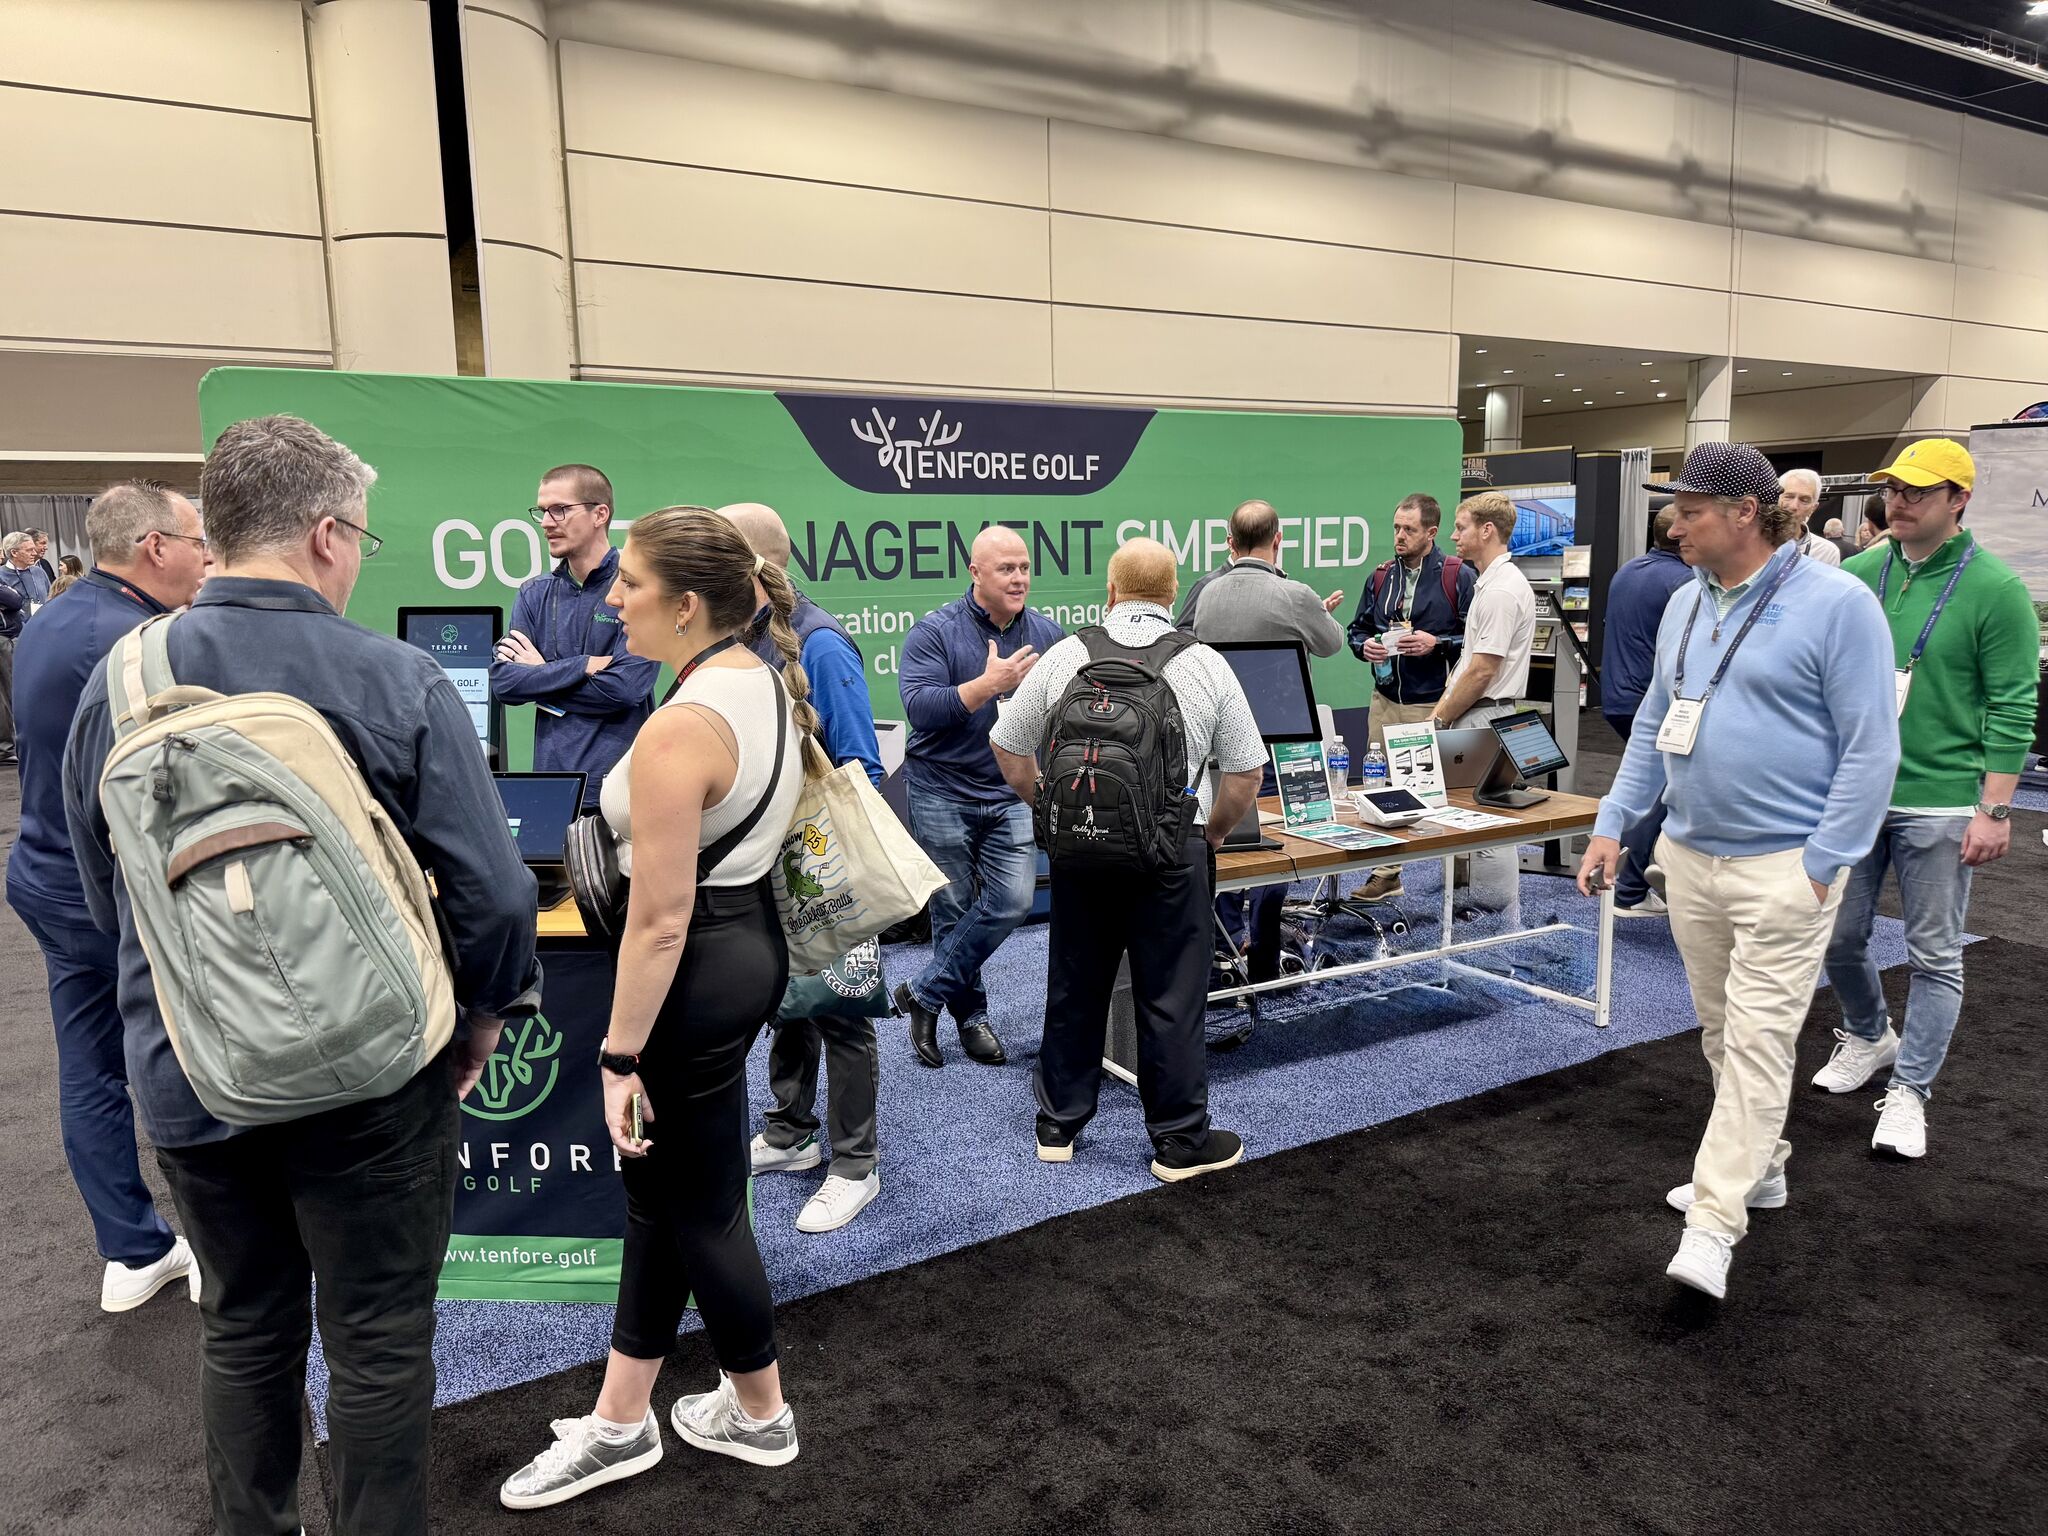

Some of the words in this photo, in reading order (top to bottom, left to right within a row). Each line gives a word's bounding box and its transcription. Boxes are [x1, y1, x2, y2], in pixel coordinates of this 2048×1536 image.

[895, 440, 1027, 481] TENFORE
[1033, 453, 1100, 481] GOLF
[1467, 458, 1487, 470] FAME
[457, 679, 479, 687] GOLF
[781, 831, 803, 852] SHOW
[788, 900, 829, 934] Breakfast
[829, 893, 853, 913] Balls
[821, 969, 879, 997] ACCESSORIES
[463, 1176, 542, 1194] GOLF
[444, 1247, 597, 1269] ww.tenfore.golf
